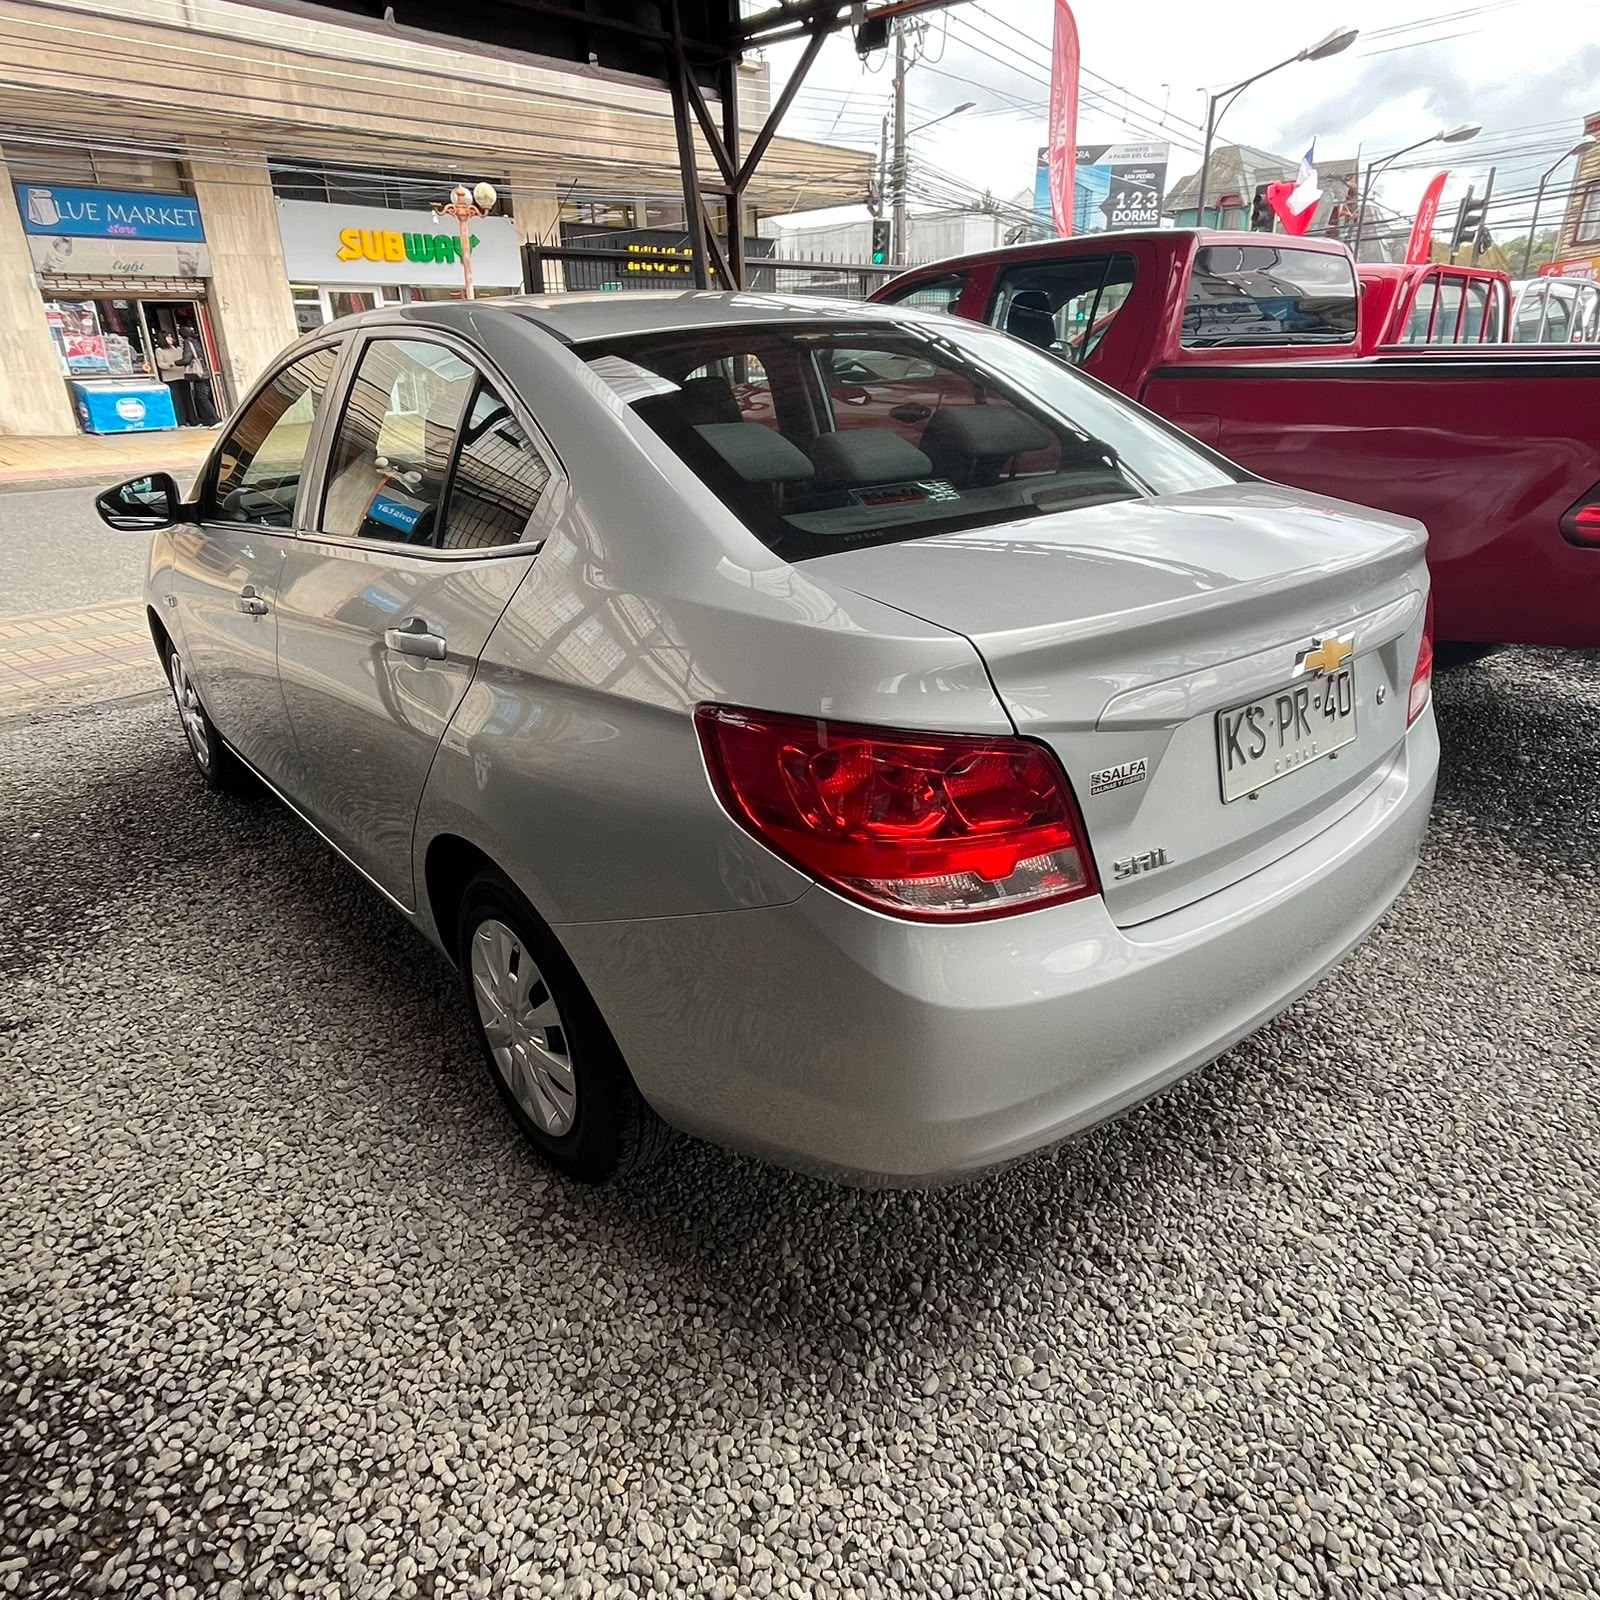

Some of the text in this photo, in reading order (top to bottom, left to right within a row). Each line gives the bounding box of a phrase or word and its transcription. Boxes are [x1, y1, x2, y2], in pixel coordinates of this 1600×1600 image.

[1135, 172, 1156, 180] PEDRO
[106, 204, 197, 227] MARKET
[1112, 209, 1159, 222] DORMS
[336, 228, 480, 264] SUBWAY
[1274, 741, 1318, 773] CHILE
[1101, 760, 1146, 783] SALFA
[1113, 847, 1175, 881] SAIL
